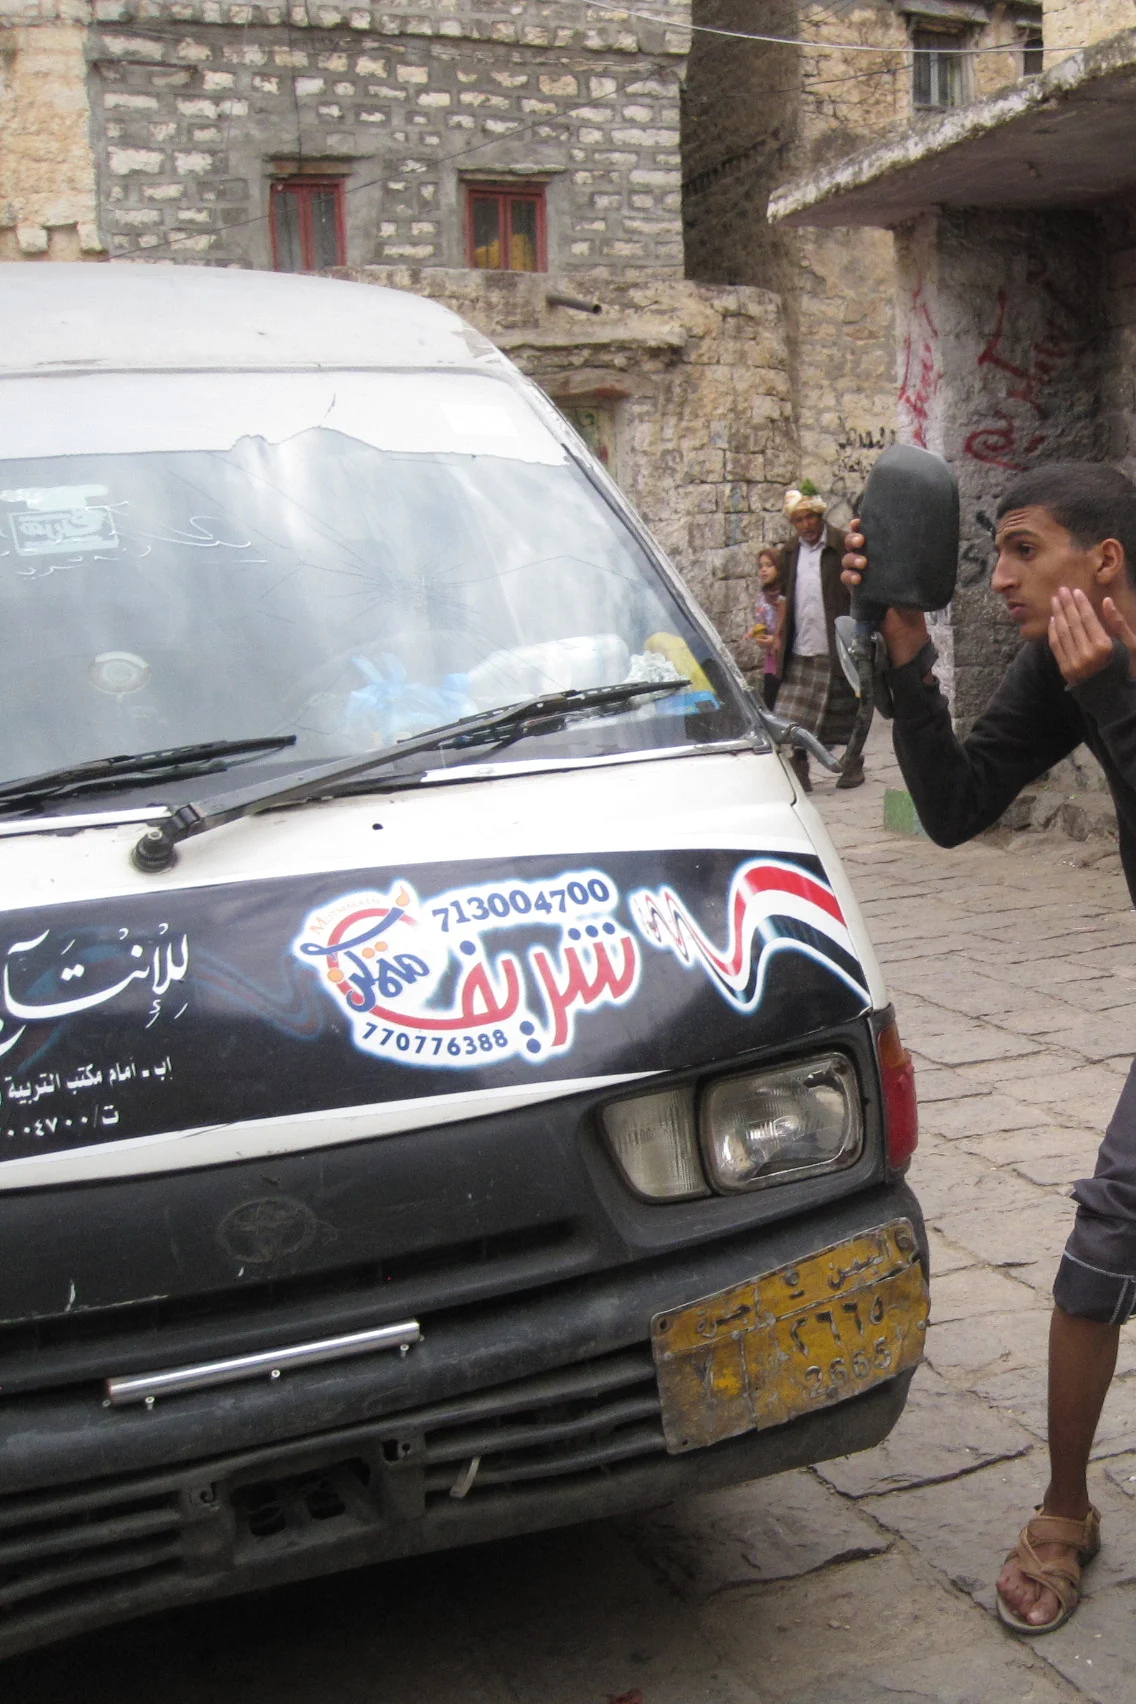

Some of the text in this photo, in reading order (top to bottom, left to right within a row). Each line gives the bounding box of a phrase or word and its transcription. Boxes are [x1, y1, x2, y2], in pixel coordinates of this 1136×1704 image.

[432, 878, 609, 932] 713004700
[362, 1022, 508, 1056] 770776388
[4, 1072, 61, 1104] التربية
[66, 1063, 103, 1095] مكتب
